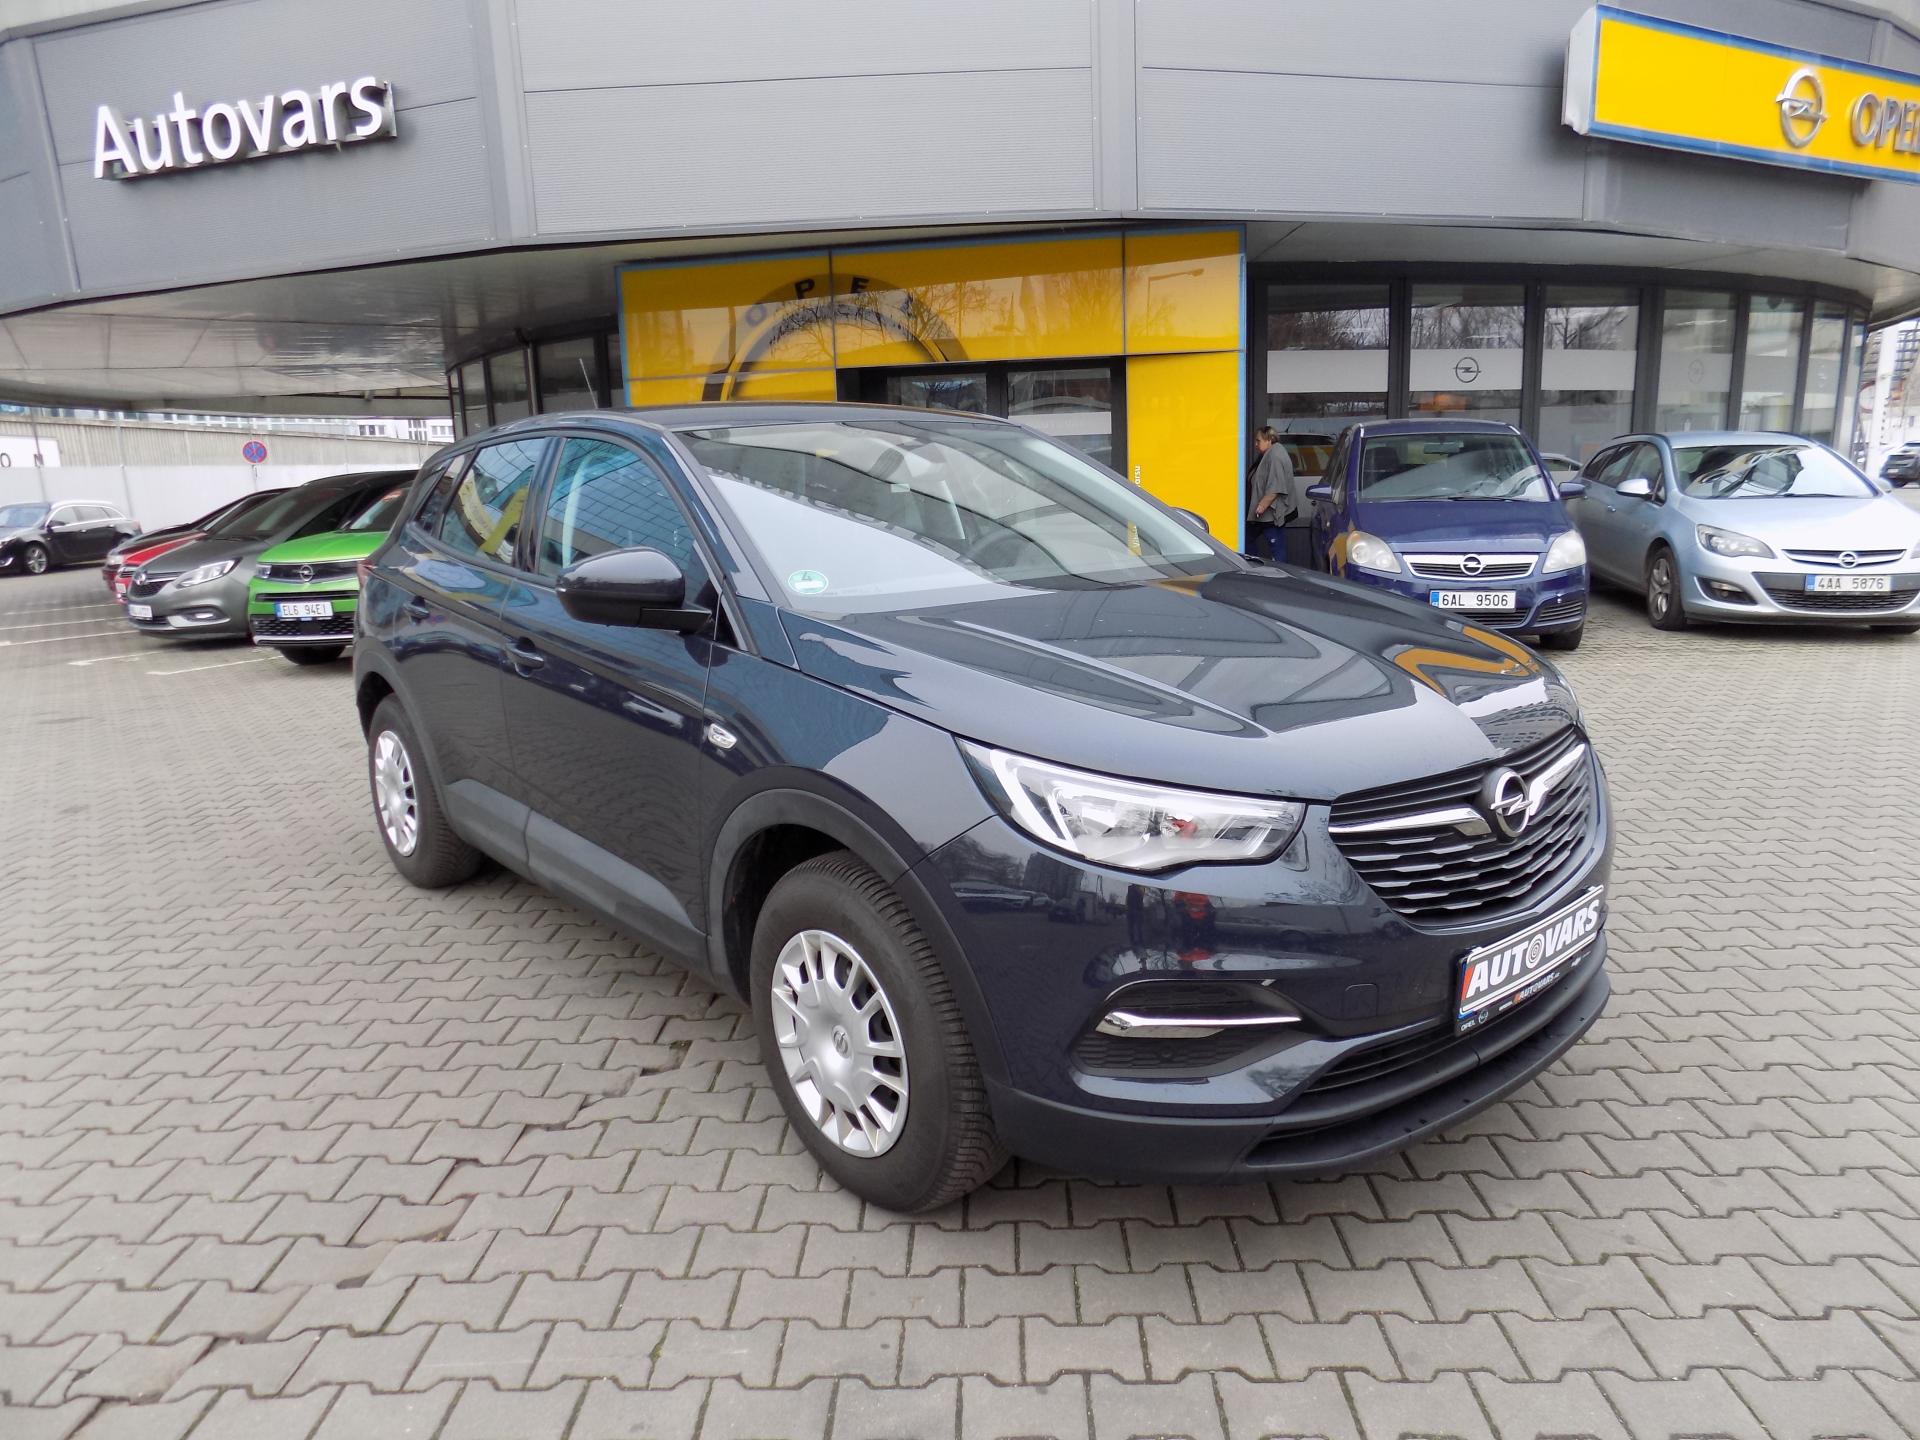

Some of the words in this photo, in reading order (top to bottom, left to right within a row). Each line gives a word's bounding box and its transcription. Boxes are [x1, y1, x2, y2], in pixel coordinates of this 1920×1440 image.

[94, 75, 384, 179] Autovars
[1818, 577, 1841, 590] 4AA
[1852, 577, 1884, 590] 5876
[1442, 594, 1465, 607] 6AL
[1476, 594, 1508, 607] 9506
[282, 604, 299, 616] EL6
[1465, 899, 1600, 999] AUTOVARS
